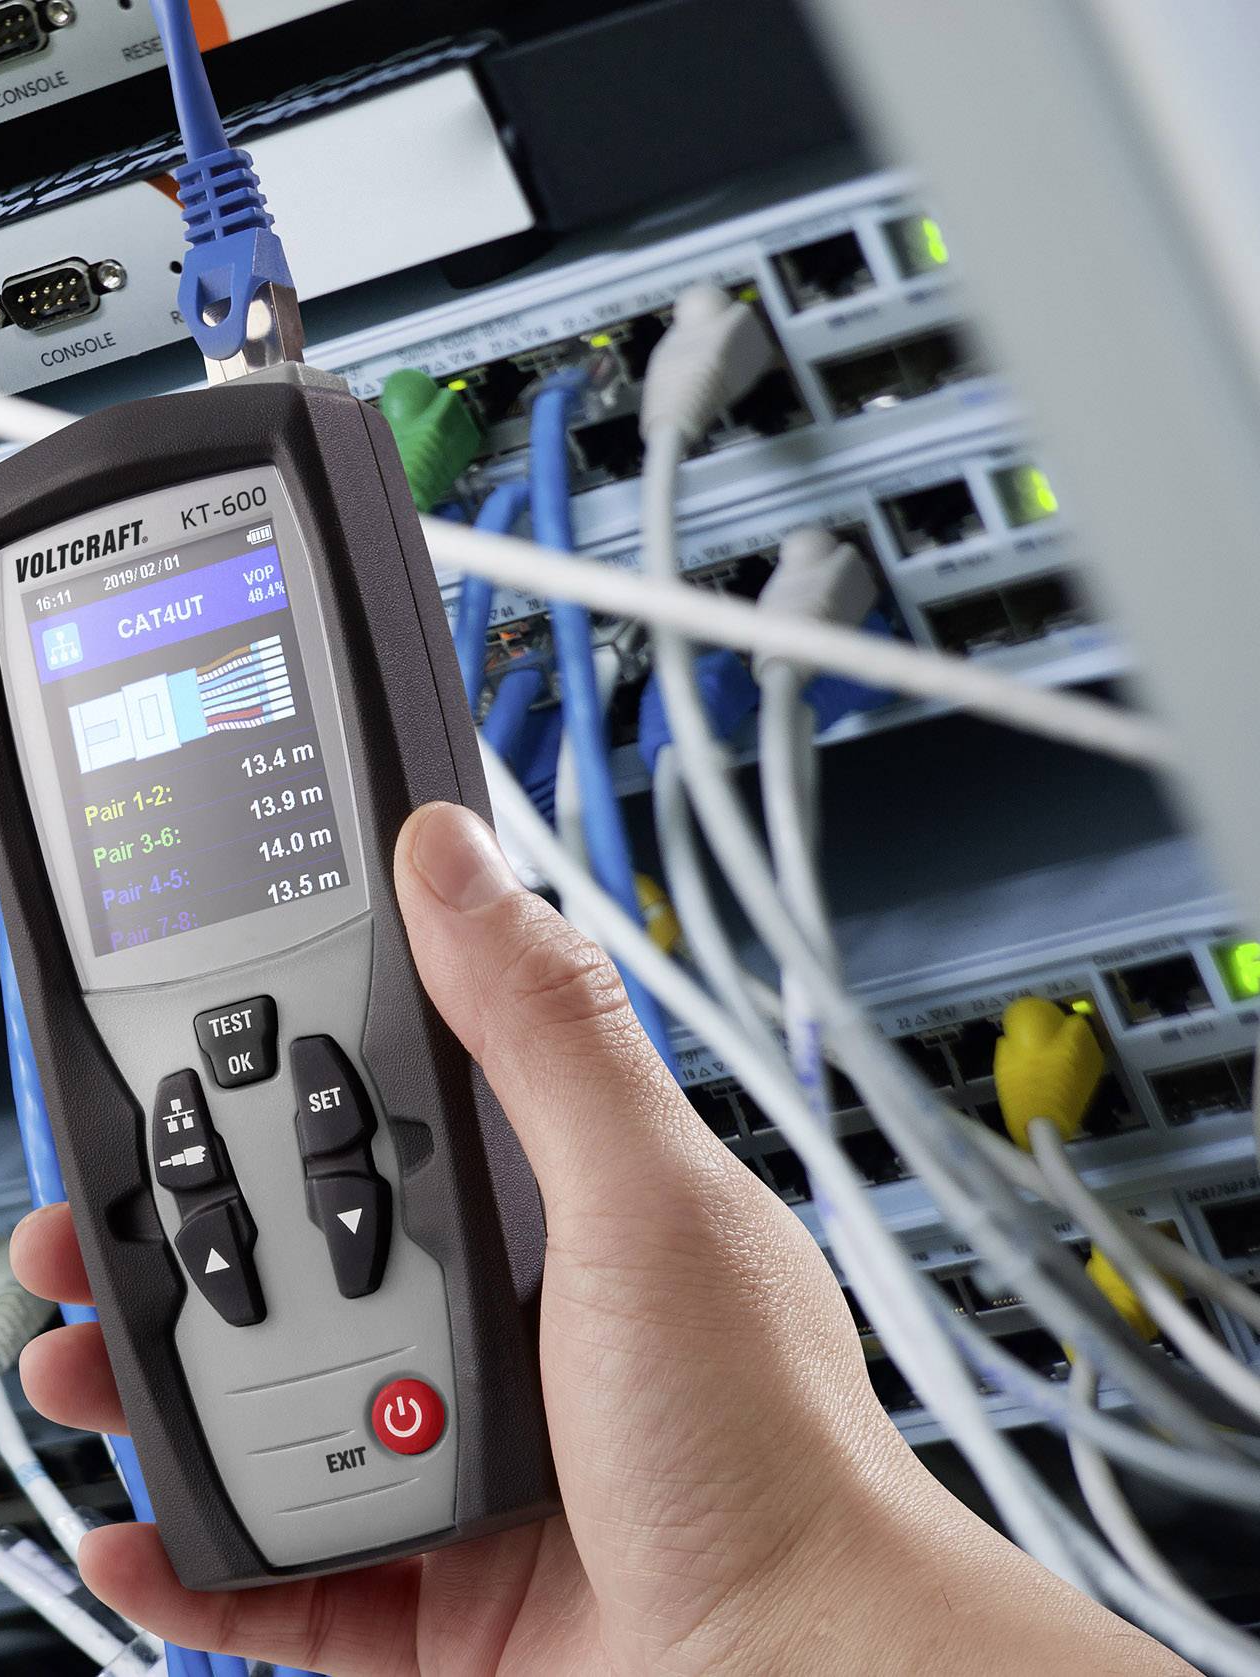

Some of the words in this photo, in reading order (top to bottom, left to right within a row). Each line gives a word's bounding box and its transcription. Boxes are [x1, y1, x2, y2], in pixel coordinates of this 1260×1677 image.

[122, 35, 164, 62] RESE
[40, 332, 116, 367] CONSOLE
[180, 486, 267, 530] KT-600
[243, 564, 275, 586] VOP
[247, 580, 286, 604] 48.4%
[35, 589, 72, 612] 16:11
[117, 594, 204, 639] CAT4UT
[241, 747, 287, 778] 13.4
[292, 743, 315, 763] m
[84, 799, 126, 827] Pair
[133, 784, 173, 811] 1-2:
[250, 789, 295, 820] 13.9
[300, 785, 324, 806] m
[93, 841, 134, 868] Pair
[140, 827, 181, 854] 3-6:
[258, 831, 305, 862] 14.0
[309, 827, 333, 848] m
[101, 883, 143, 910] Pair
[149, 868, 190, 894] 4-5:
[267, 873, 314, 905] 13.5
[318, 869, 342, 889] m
[110, 926, 150, 952] Pair
[157, 911, 199, 937] 7-8:
[208, 1010, 253, 1039] TEST
[228, 1052, 254, 1076] OK
[308, 1086, 342, 1114] SET
[325, 1446, 367, 1474] EXIT
